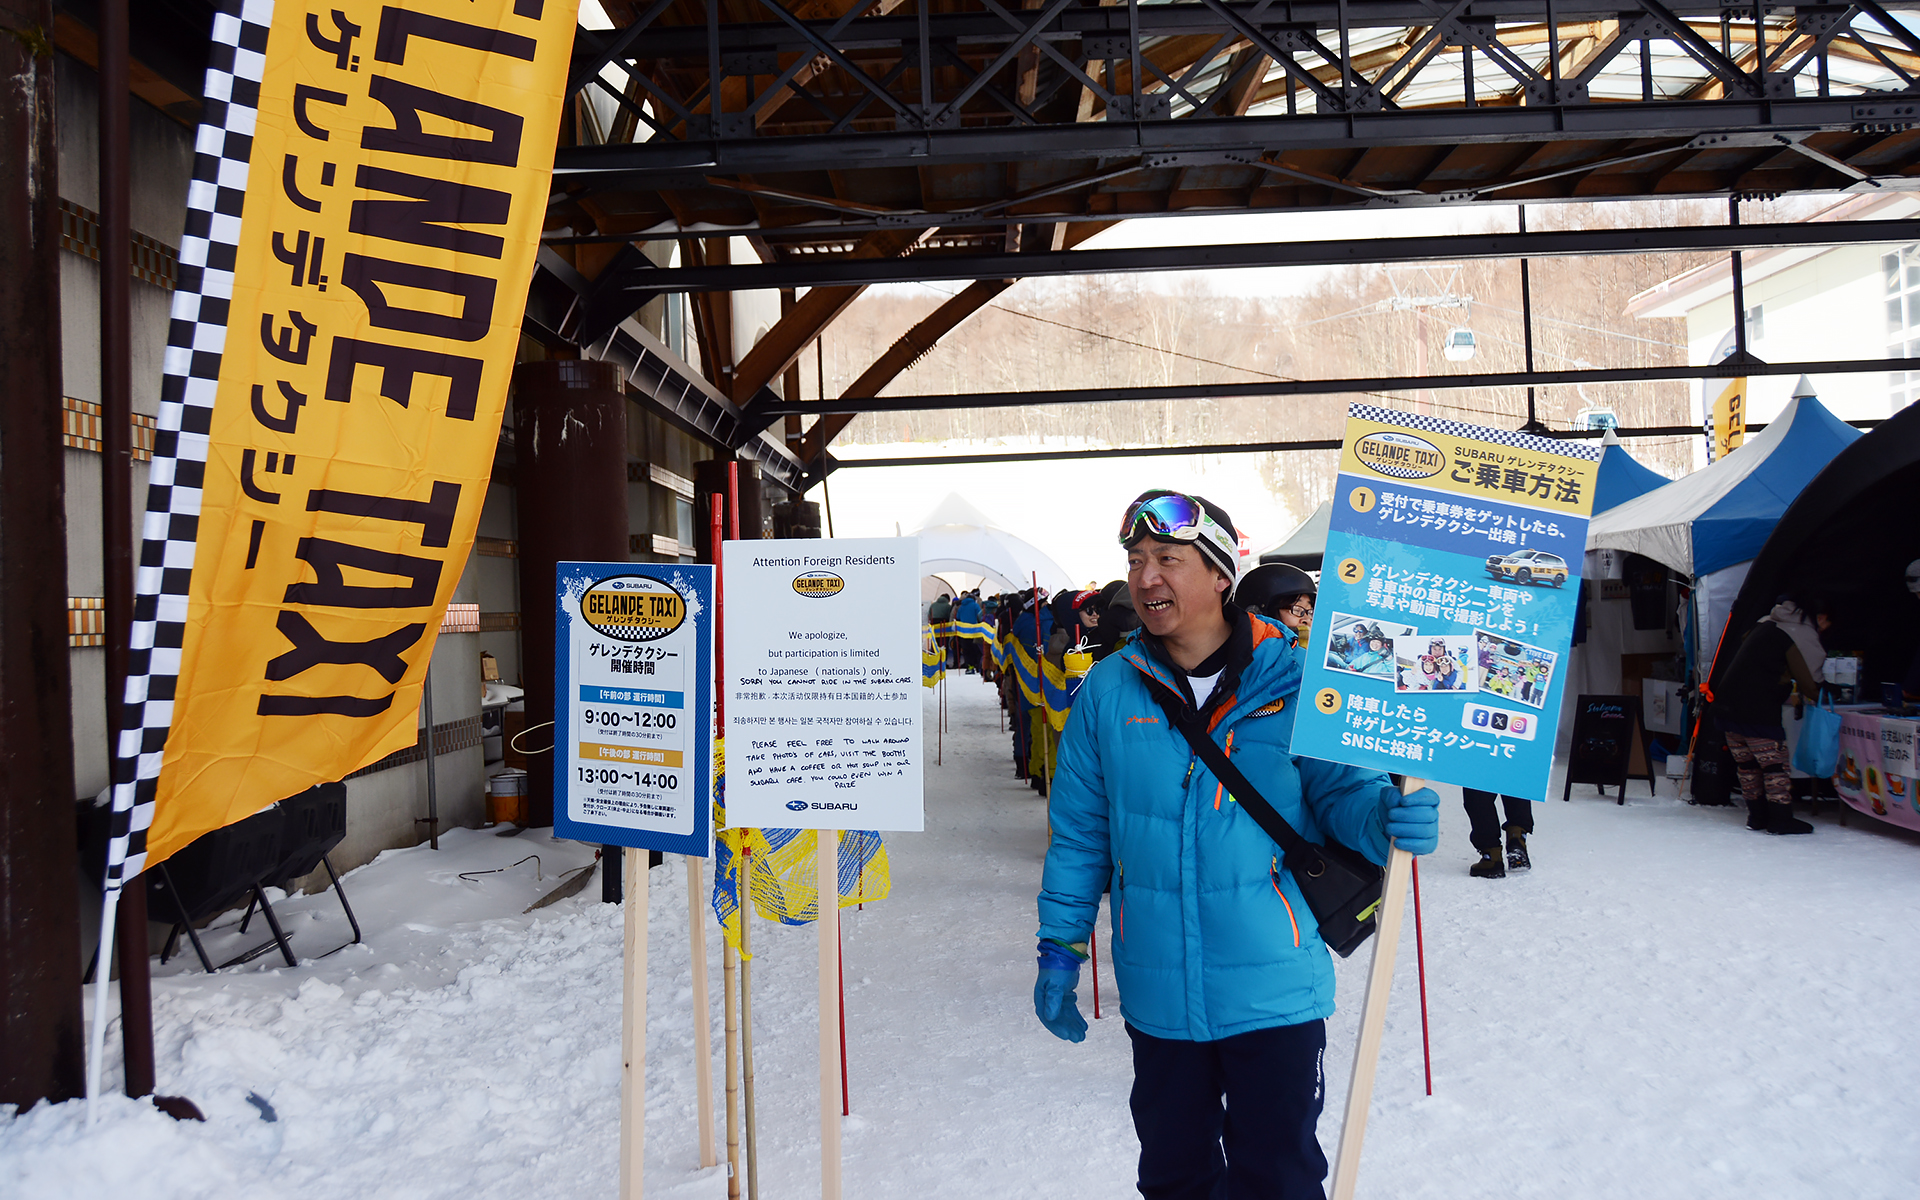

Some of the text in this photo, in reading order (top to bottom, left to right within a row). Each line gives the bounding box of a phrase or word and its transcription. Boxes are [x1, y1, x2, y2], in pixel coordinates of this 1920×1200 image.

[240, 9, 362, 570] ゲレンデタクシー
[257, 0, 545, 718] LANDE TAXI
[1395, 437, 1420, 446] SUBARU
[1362, 440, 1439, 468] GELANDE TAXI
[1454, 446, 1585, 477] SUBARU ゲレンデタクシー
[1375, 457, 1423, 470] ゲレンデタクシー
[1450, 459, 1582, 505] ご乗車方法
[1380, 491, 1567, 539] 受付で乗車券をゲットしたら、
[1378, 508, 1526, 546] ゲレンデタクシー出発！
[752, 555, 895, 567] Attention Foreign Residents
[1344, 563, 1357, 578] 2
[796, 579, 841, 588] GELANDE TAXI
[1370, 562, 1533, 606] ゲレンデタクシー車両や
[1368, 577, 1516, 618] 乗車中の車内シーンを
[589, 594, 677, 618] GELANDE TAXI
[1365, 590, 1539, 636] 写真や動画で撮影しよう！
[606, 615, 661, 625] ゲレンデタクシー
[788, 630, 848, 641] We apologize,
[589, 642, 678, 661] ゲレンデタクシー
[768, 648, 880, 659] but participation is limited
[610, 658, 655, 676] 開催時間
[758, 668, 768, 676] to
[769, 667, 809, 677] Japanese
[870, 667, 892, 677] only.
[740, 677, 764, 686] SORRY
[1322, 693, 1335, 709] 3
[1347, 693, 1428, 723] 降車したら
[733, 716, 914, 726] 죄송하지만 본 행사는 일본 국적자만 참여하실 수 있습니다.
[1344, 711, 1516, 759] 「#ゲレンデタクシー」で
[751, 740, 778, 749] PLEASE
[815, 738, 833, 746] FREE
[1341, 731, 1434, 762] SNSに投稿！
[881, 749, 906, 757] BOOTHS
[748, 767, 763, 776] AND
[769, 765, 787, 774] HAVE
[800, 762, 826, 771] COFFEE
[831, 762, 842, 770] OR
[862, 760, 880, 769] SOUP
[896, 759, 911, 767] OUR
[827, 773, 848, 781] COULD
[834, 781, 856, 789] PRIZE
[811, 802, 858, 811] SUBARU
